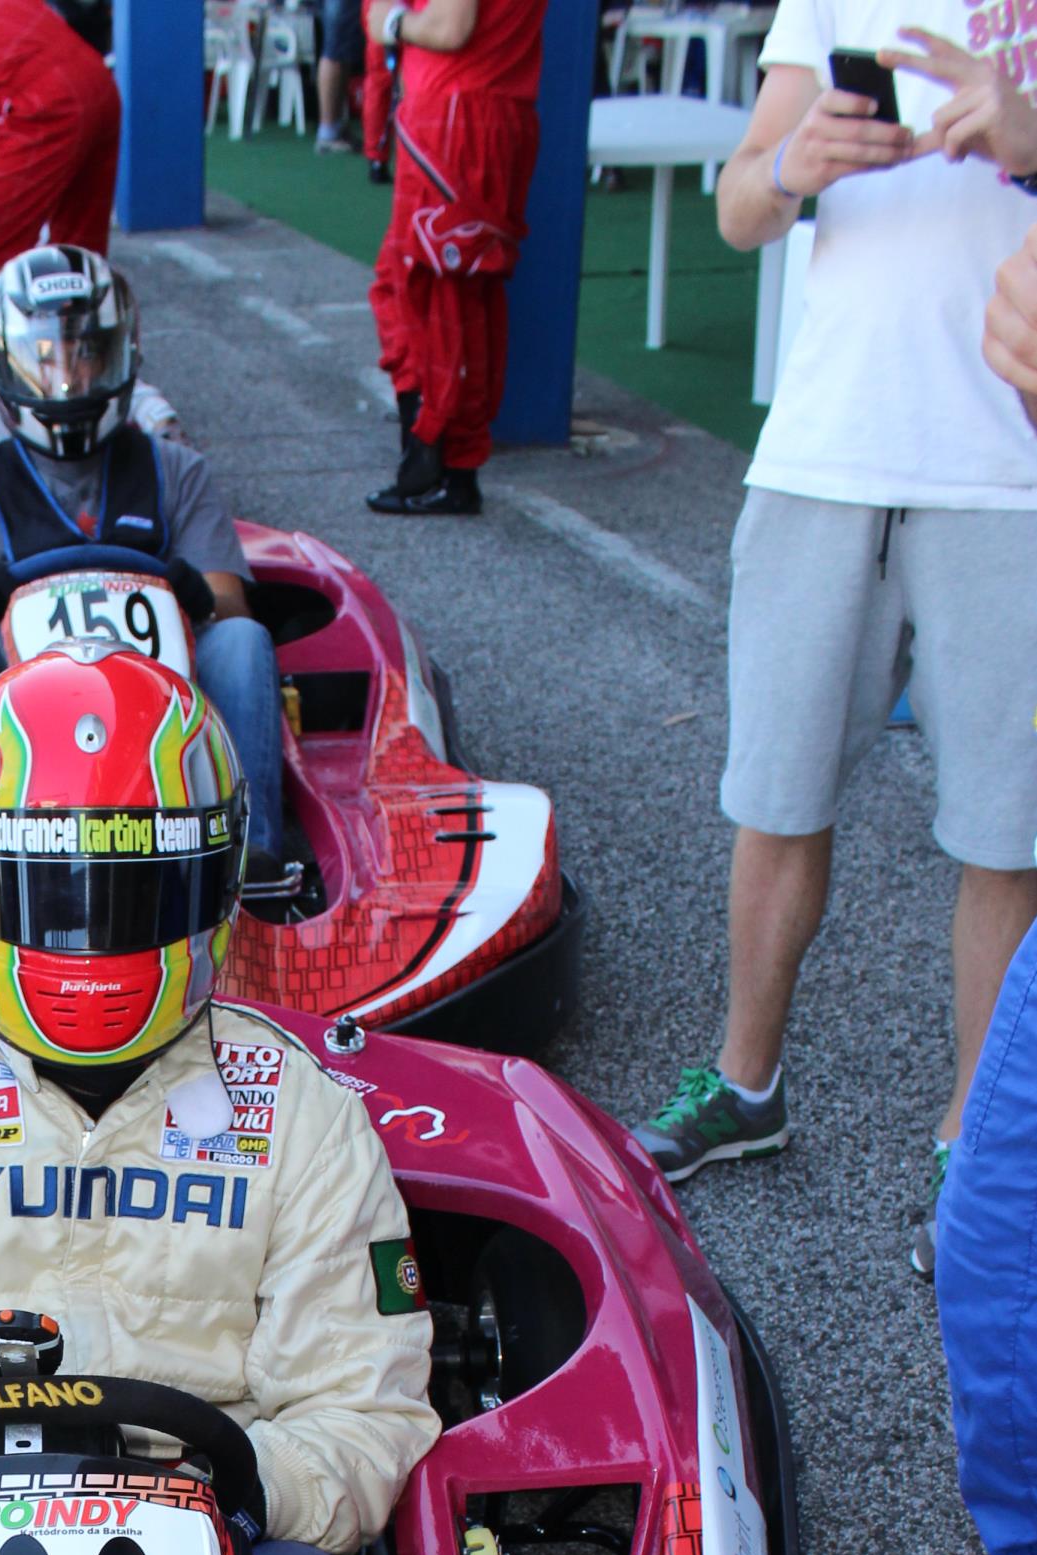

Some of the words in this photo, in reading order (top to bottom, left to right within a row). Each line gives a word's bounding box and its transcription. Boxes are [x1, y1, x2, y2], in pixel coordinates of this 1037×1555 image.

[48, 588, 161, 660] 159
[79, 813, 153, 855] karting
[155, 812, 201, 852] team
[213, 1152, 254, 1163] FERODO
[87, 1527, 100, 1535] da
[102, 1528, 143, 1536] Batalha
